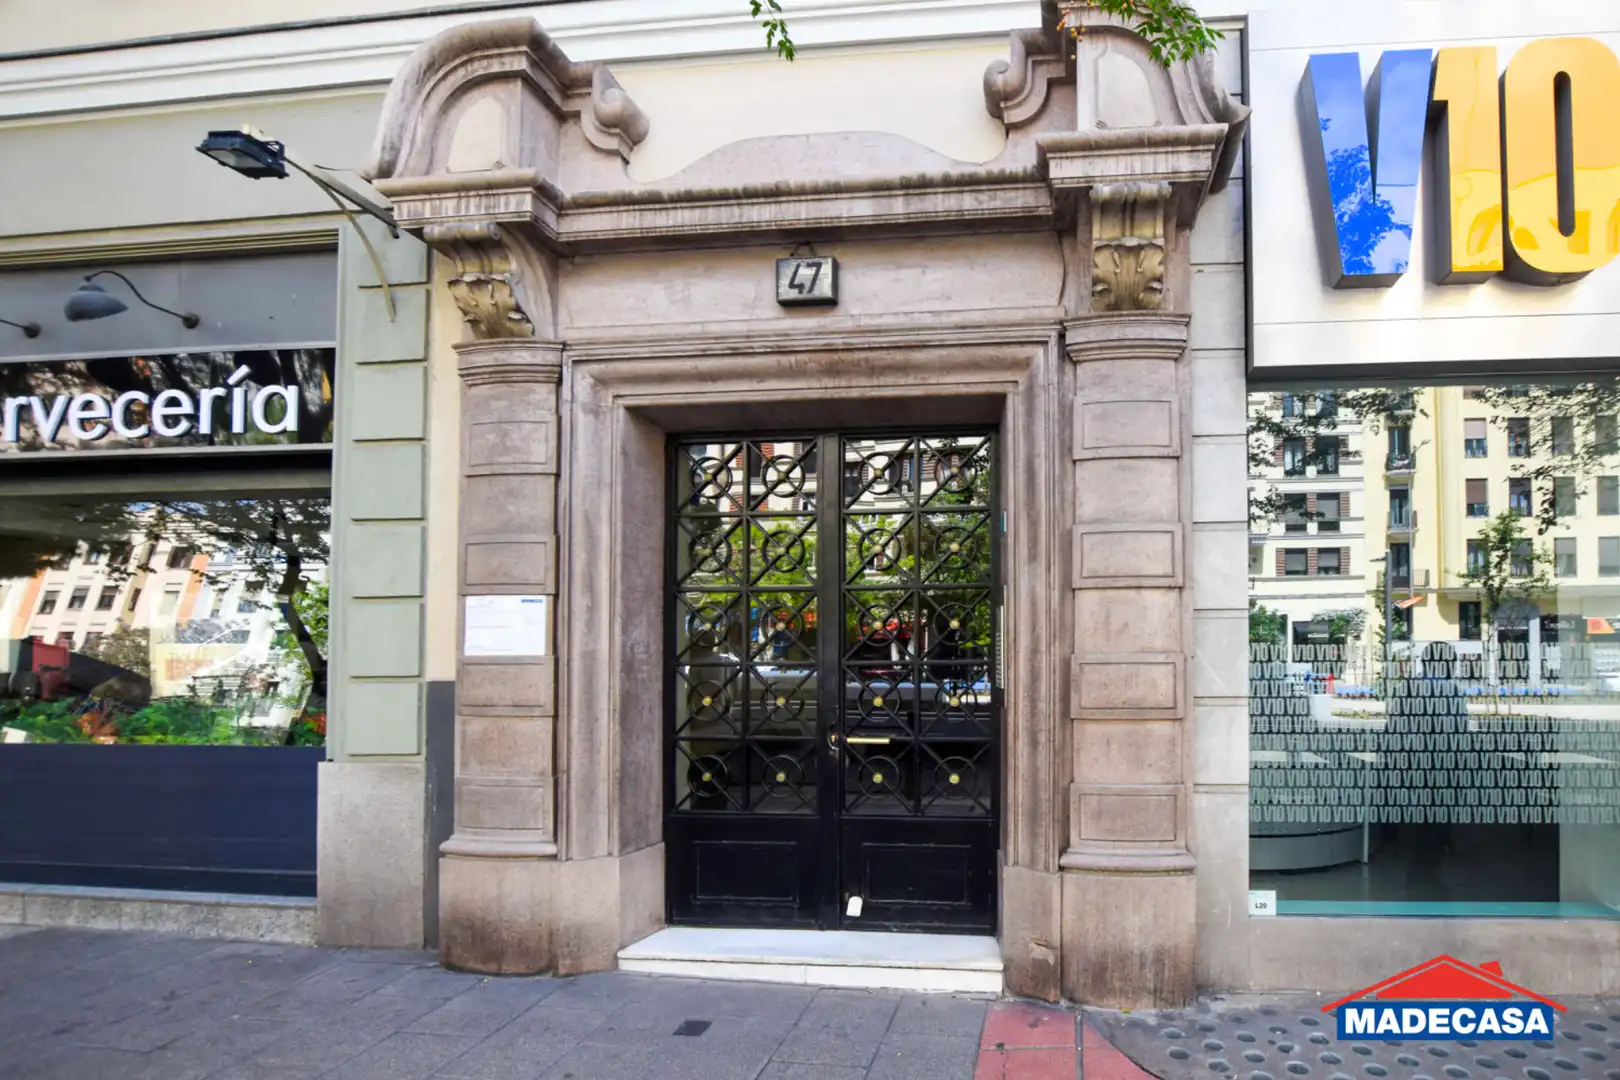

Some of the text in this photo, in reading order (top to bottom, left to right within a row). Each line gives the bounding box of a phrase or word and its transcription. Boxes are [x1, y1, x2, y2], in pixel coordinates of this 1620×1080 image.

[1298, 37, 1620, 287] V10
[788, 262, 823, 294] 47
[2, 364, 299, 442] rvecería
